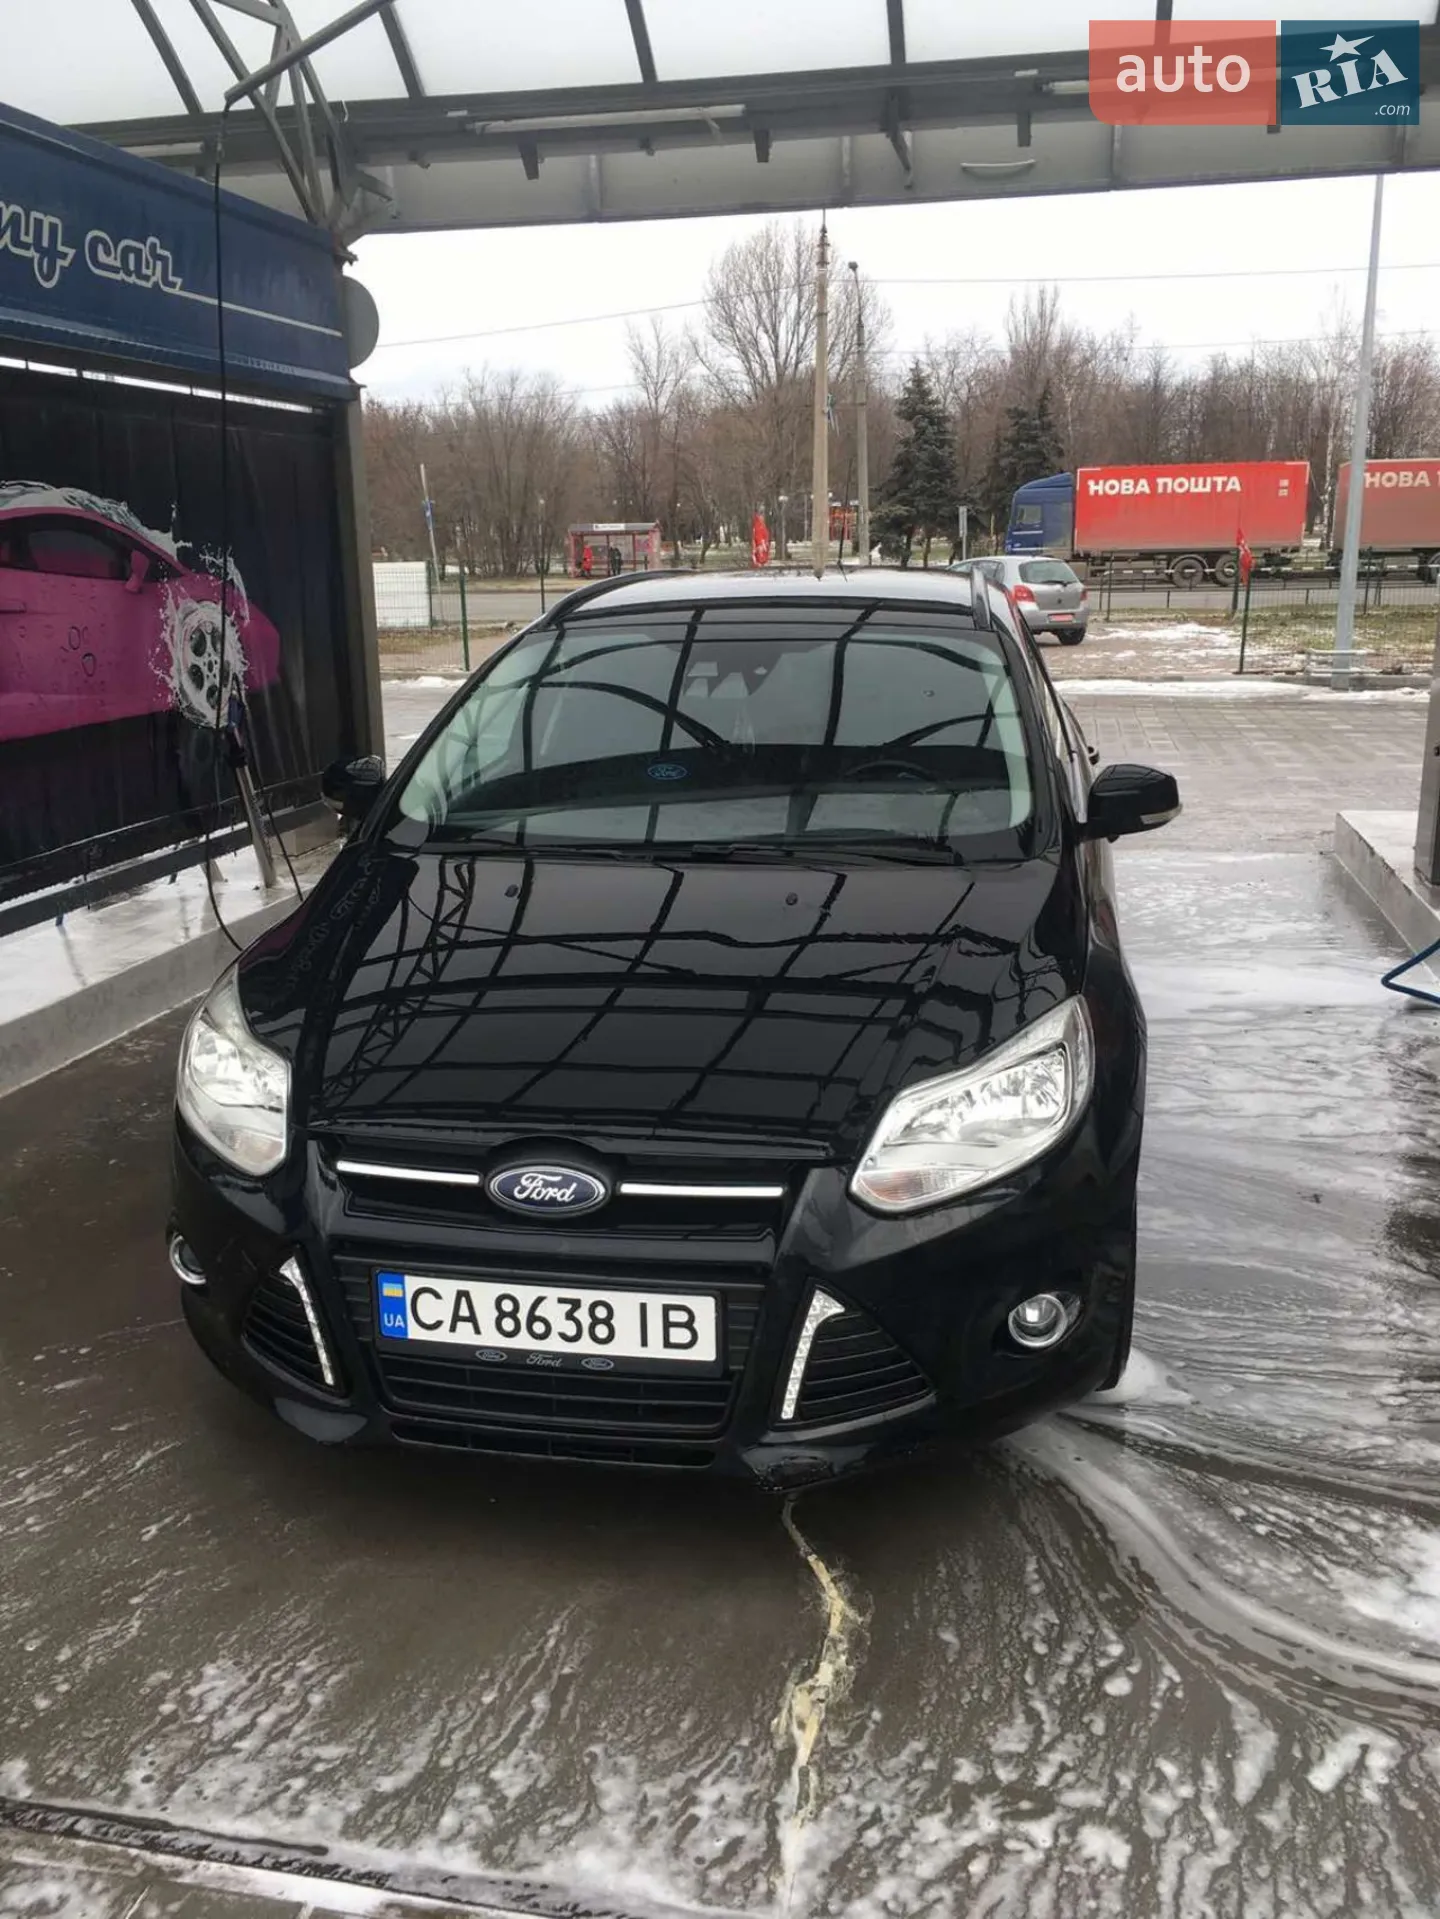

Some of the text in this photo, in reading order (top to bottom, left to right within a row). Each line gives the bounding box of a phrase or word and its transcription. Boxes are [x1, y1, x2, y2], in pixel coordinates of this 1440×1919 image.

[84, 229, 183, 293] car
[1087, 476, 1241, 496] НОВА ПОШТА
[1364, 471, 1431, 488] НОВА
[513, 1173, 578, 1202] Ford
[384, 1314, 405, 1329] UA
[410, 1287, 699, 1350] CA 8638 IB
[526, 1352, 563, 1368] Ford
